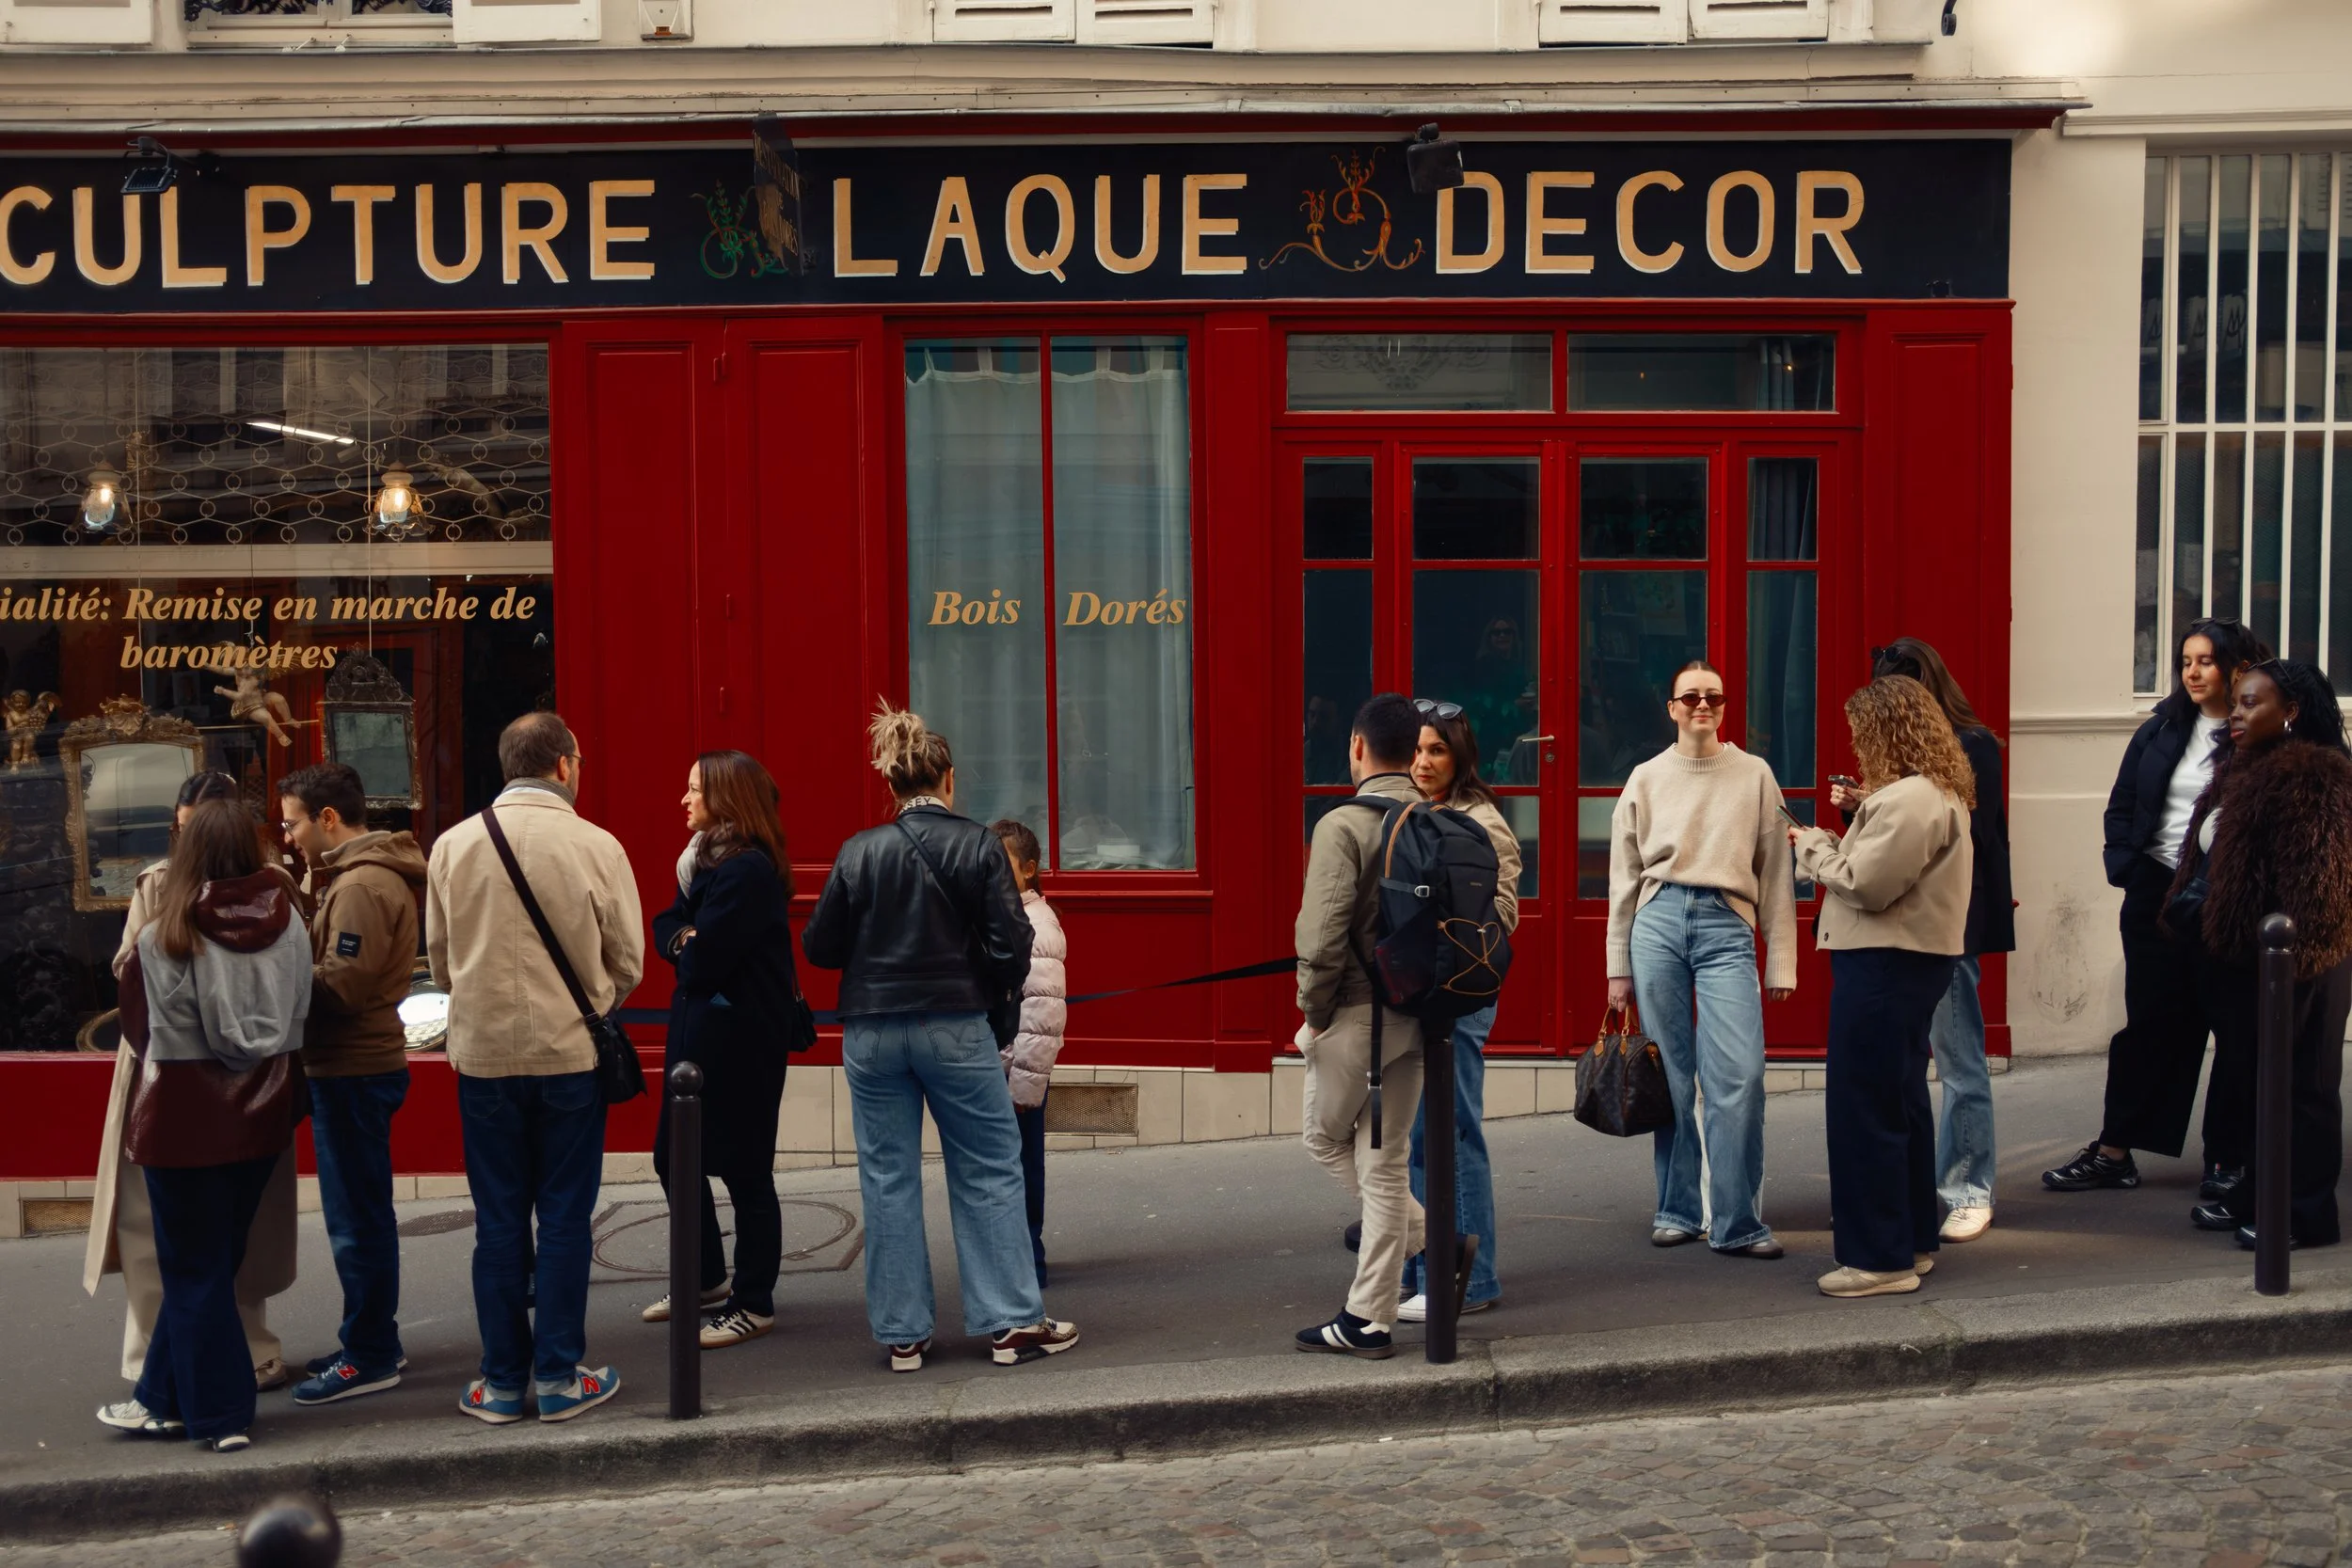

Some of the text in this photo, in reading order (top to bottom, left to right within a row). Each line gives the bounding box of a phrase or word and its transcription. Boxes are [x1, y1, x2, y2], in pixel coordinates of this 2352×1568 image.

[0, 179, 656, 287] CULPTURE
[833, 173, 1248, 283] LAQUE
[1436, 169, 1865, 275] DECOR
[121, 587, 262, 621] Remise
[273, 596, 318, 621] en
[330, 586, 480, 621] marche
[489, 586, 536, 621] de
[927, 588, 1186, 626] Bois Dorés
[119, 634, 339, 670] baromètres
[581, 1376, 601, 1394] N
